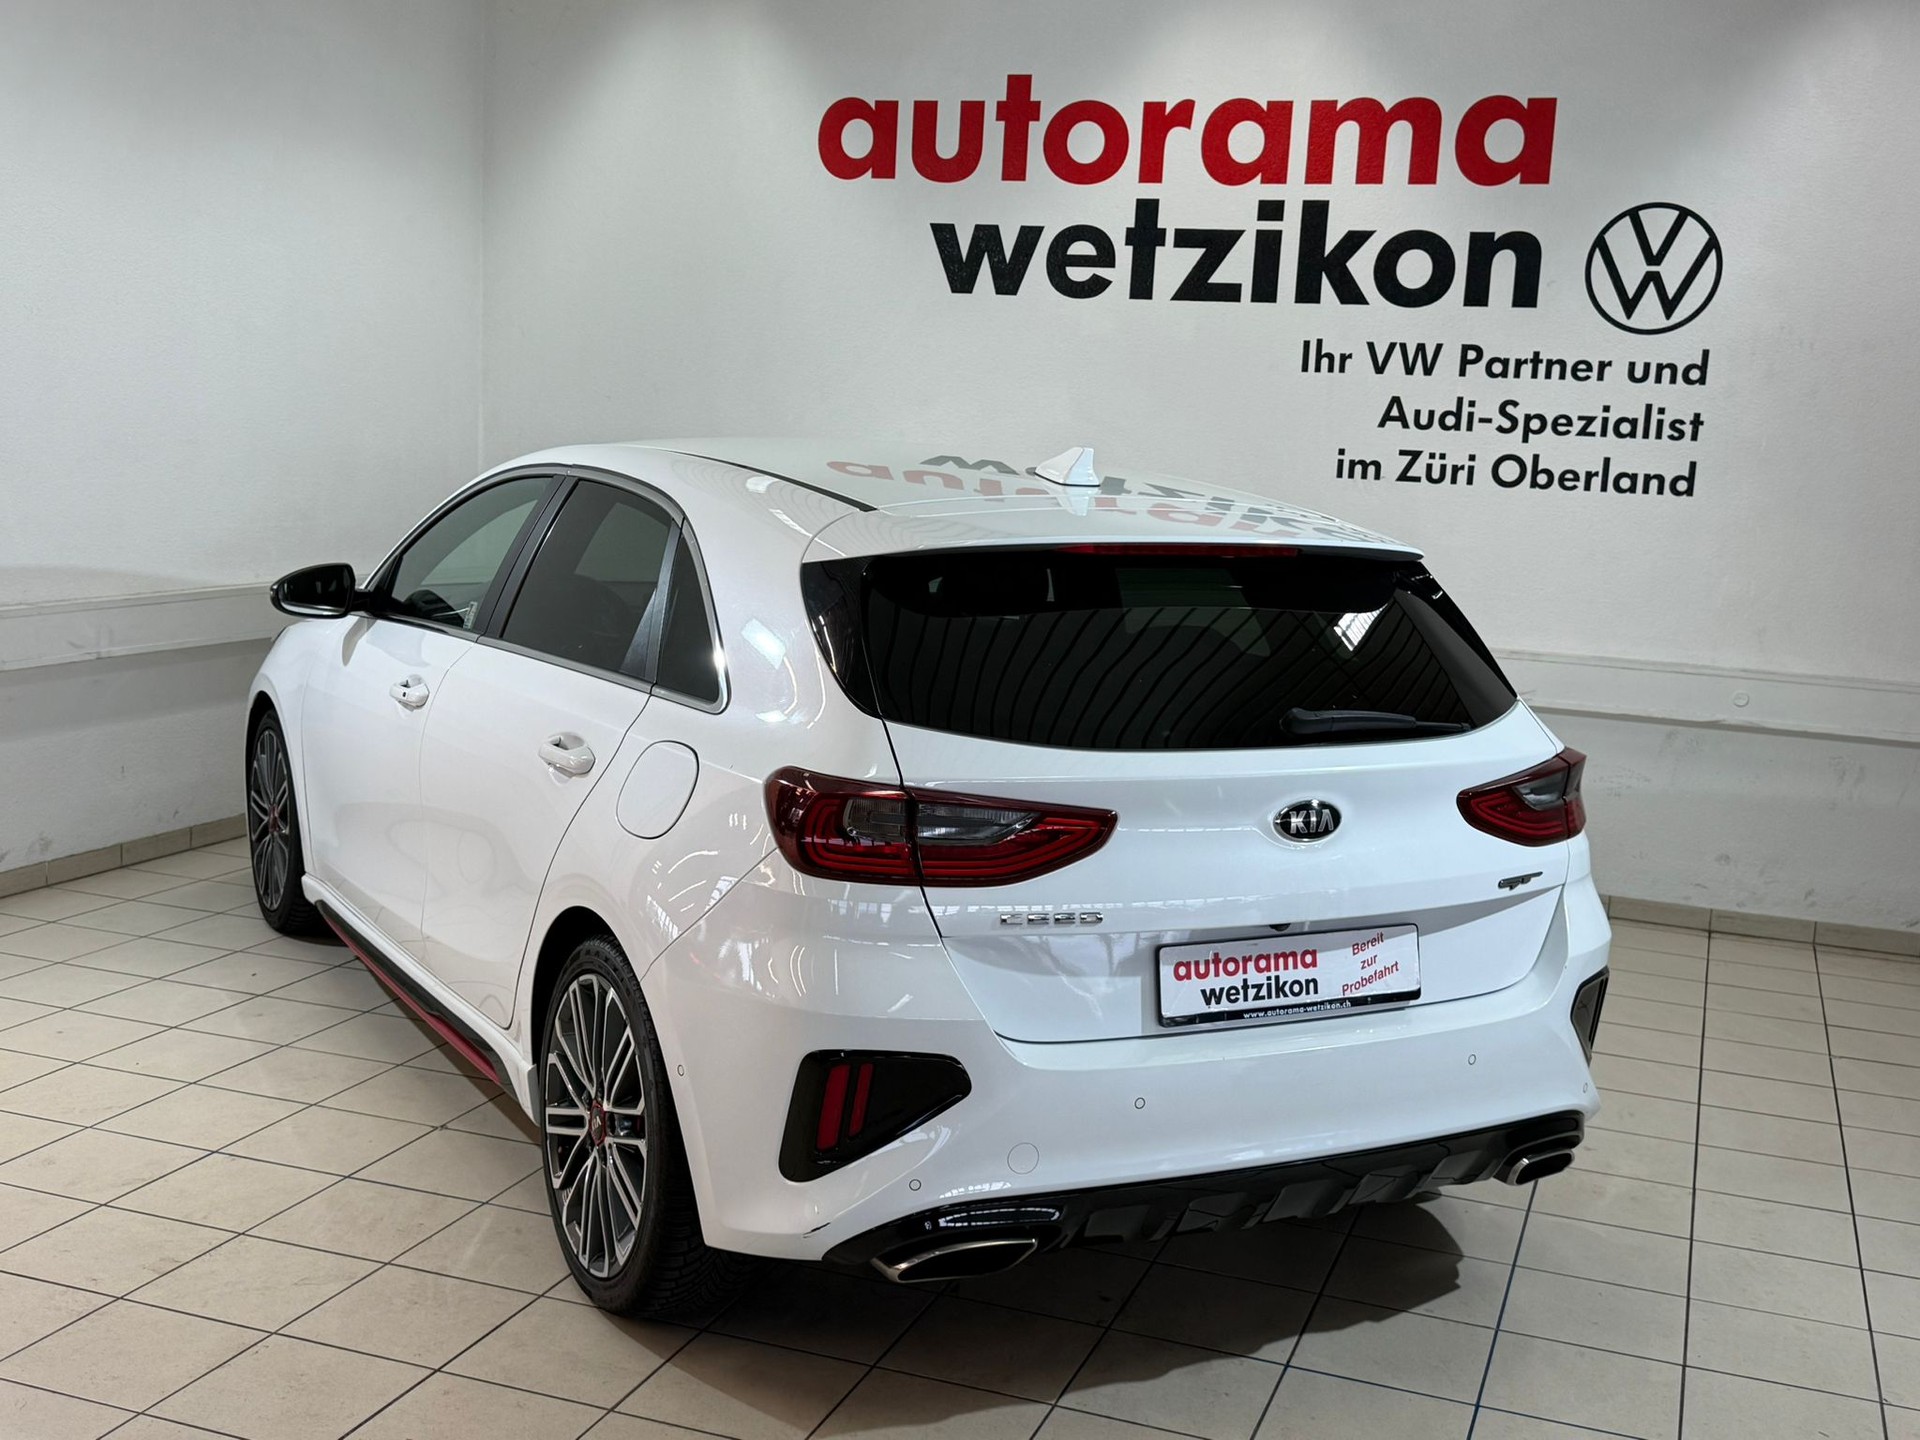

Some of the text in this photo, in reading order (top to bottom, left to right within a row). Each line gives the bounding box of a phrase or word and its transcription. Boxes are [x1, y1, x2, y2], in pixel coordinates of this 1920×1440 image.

[819, 75, 1557, 186] autorama
[930, 199, 1542, 308] wetzikon
[1301, 338, 1710, 386] Ihr VW Partner und
[1377, 395, 1705, 444] Audi-Spezialist
[1336, 448, 1697, 497] im Züri Oberland
[1289, 808, 1334, 834] KIA
[1351, 931, 1385, 956] Bereit
[1173, 949, 1318, 981] autorama
[1341, 960, 1400, 997] Probefahrt
[1360, 953, 1378, 971] zur
[1200, 976, 1319, 1007] wetzikon
[1243, 999, 1352, 1019] www.autorama-wetzikon.ch
